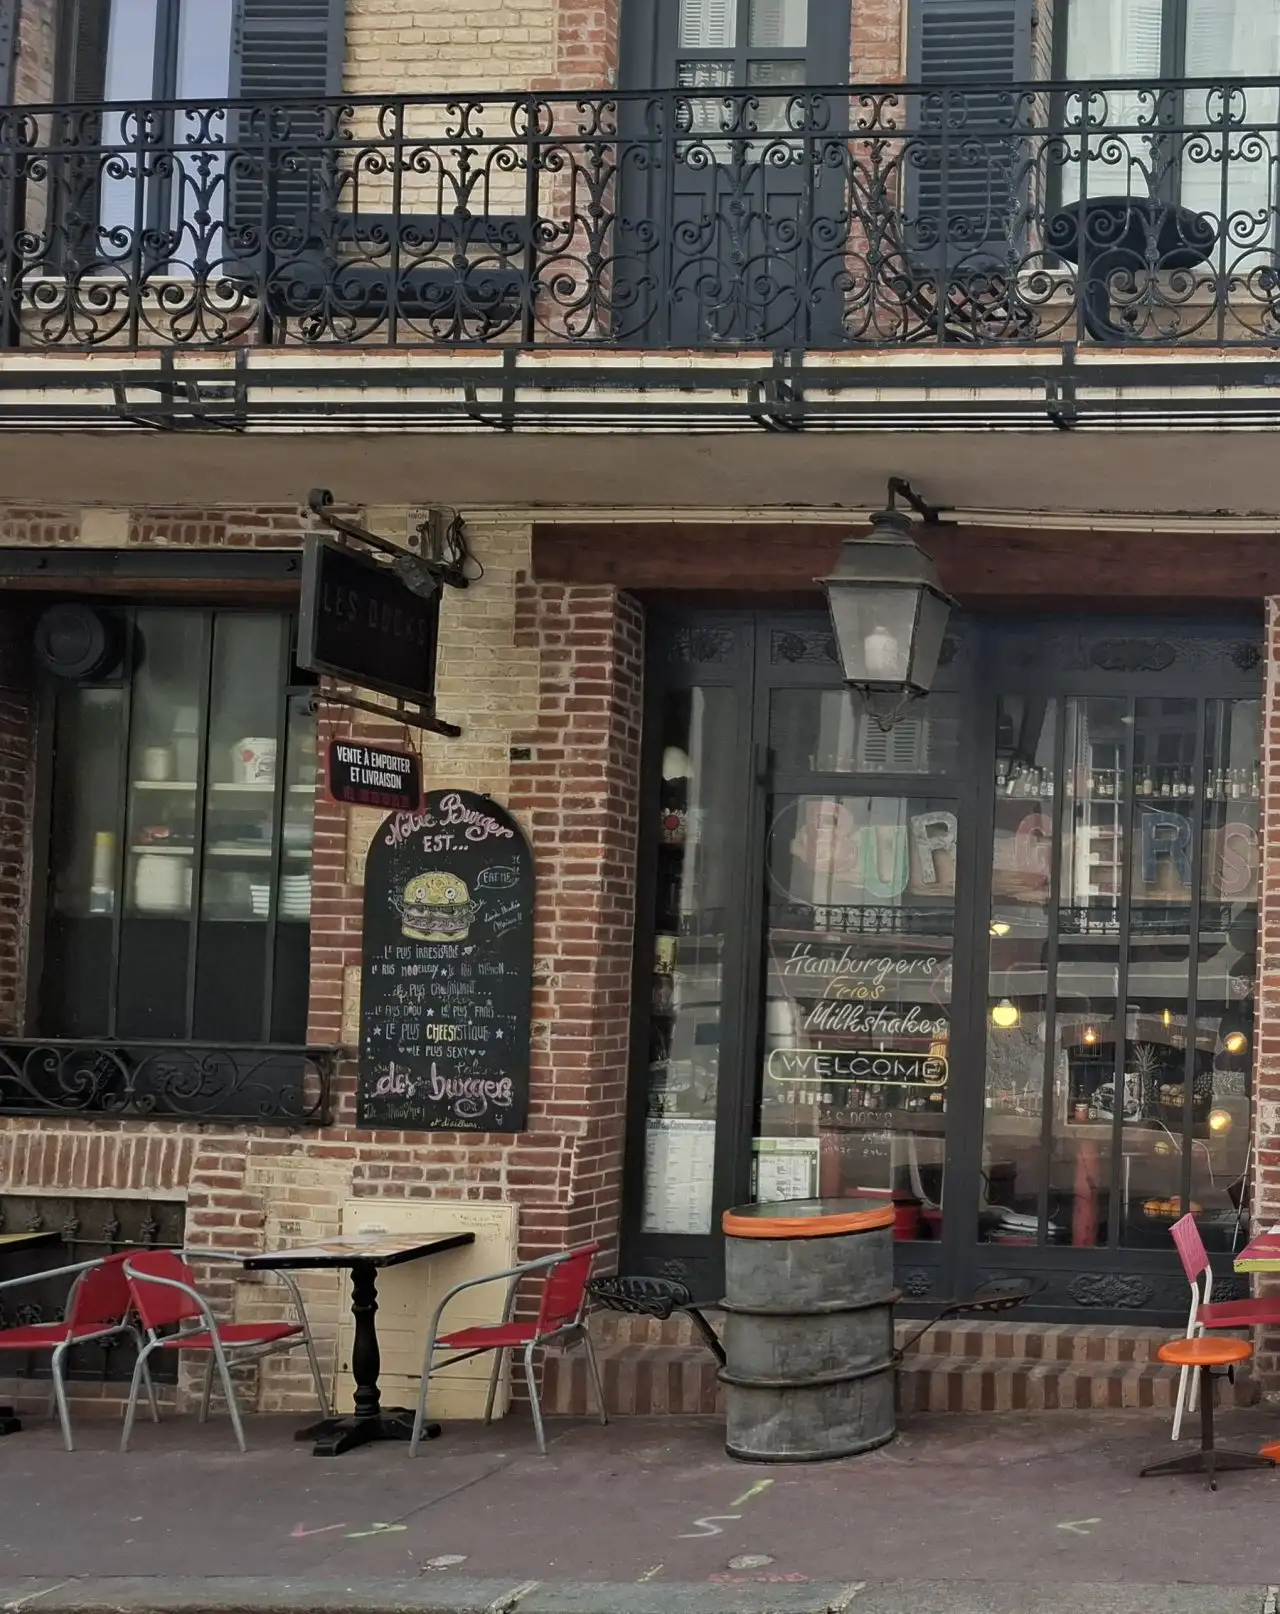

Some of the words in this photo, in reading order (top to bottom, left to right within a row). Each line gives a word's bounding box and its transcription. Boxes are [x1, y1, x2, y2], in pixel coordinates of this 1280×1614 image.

[336, 745, 362, 765] VENTE
[364, 747, 370, 766] À
[371, 752, 411, 773] EMPORTER
[350, 767, 360, 782] ET
[361, 768, 401, 789] LIVRAISON
[440, 793, 514, 841] Burger
[396, 946, 412, 959] PLUS
[785, 943, 936, 984] Hamburgers
[824, 976, 886, 999] Fries
[453, 1005, 468, 1017] PLUS
[804, 1002, 946, 1034] Milkshakes
[385, 1023, 396, 1040] LE
[401, 1023, 420, 1041] PLUS
[412, 1046, 420, 1056] LE
[425, 1046, 443, 1057] PLUS
[446, 1046, 468, 1058] SEXY
[783, 1055, 942, 1079] WELCOME
